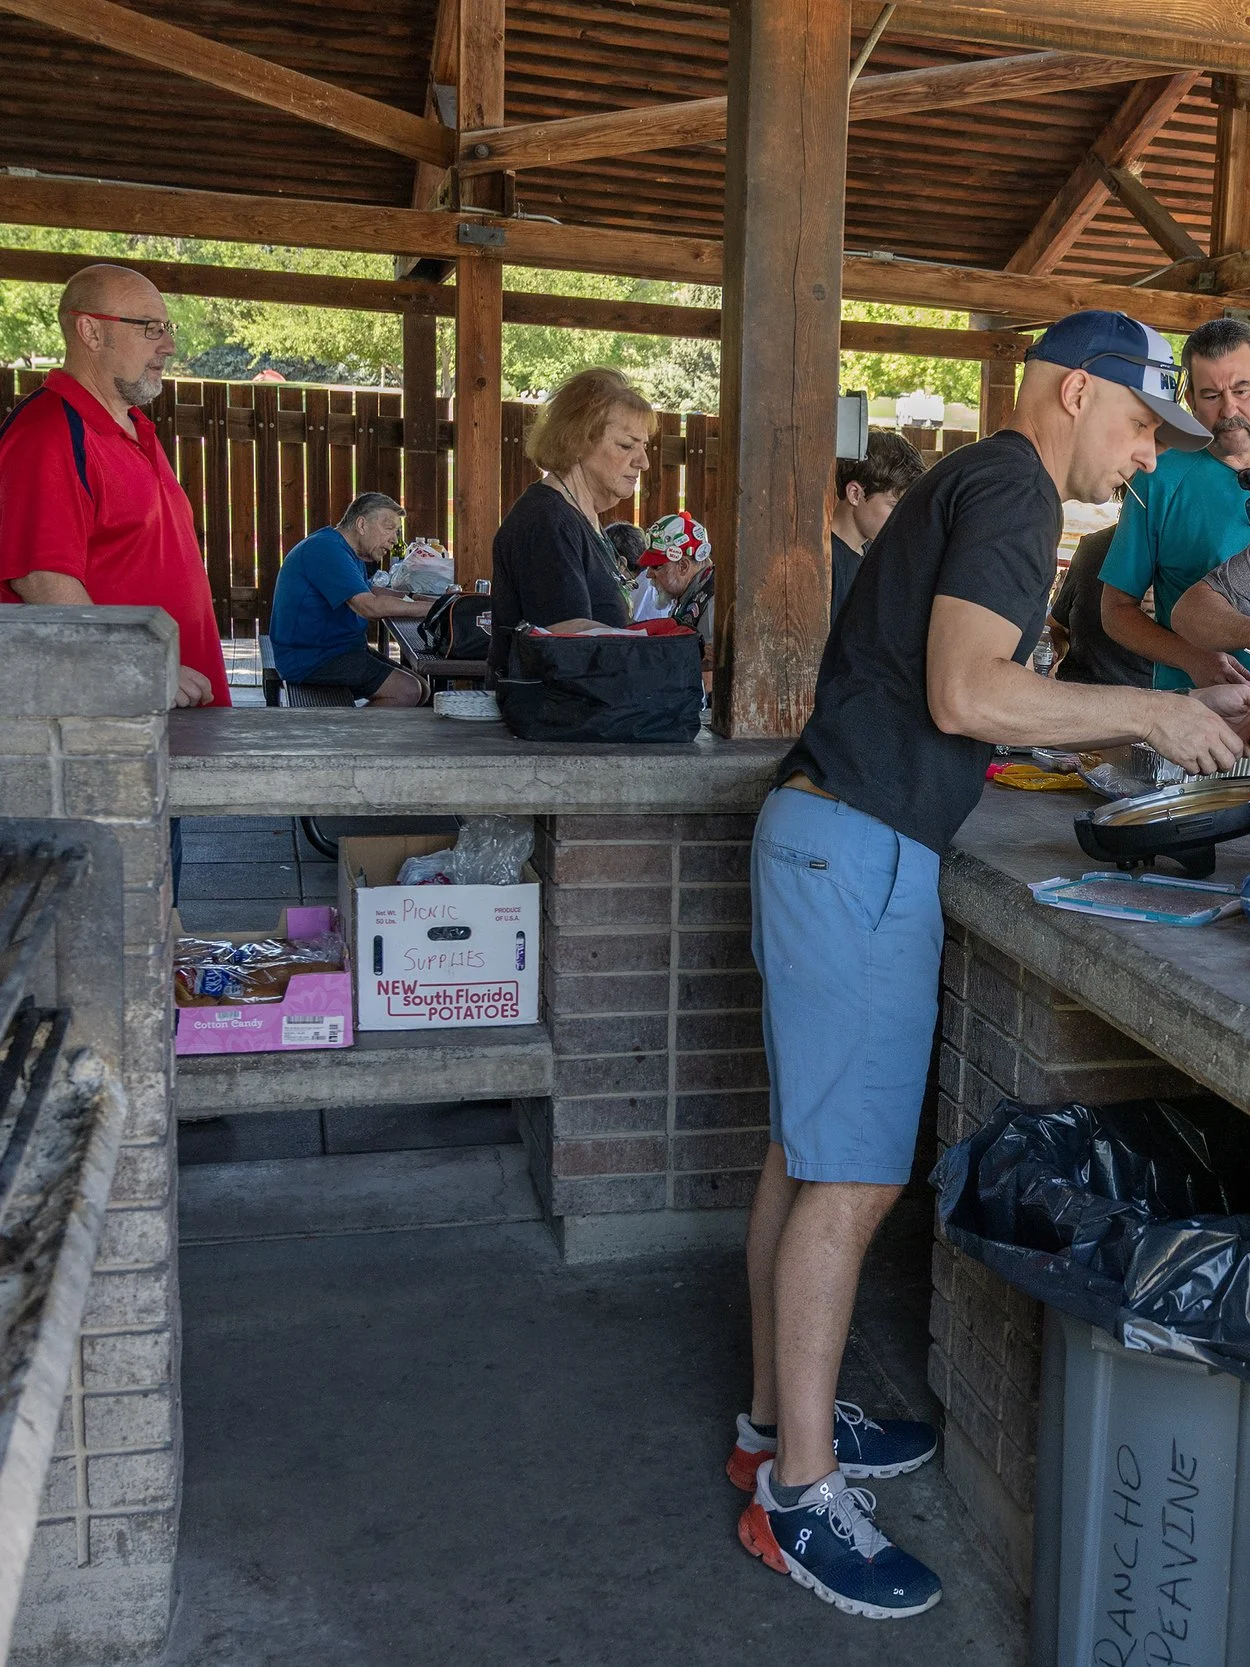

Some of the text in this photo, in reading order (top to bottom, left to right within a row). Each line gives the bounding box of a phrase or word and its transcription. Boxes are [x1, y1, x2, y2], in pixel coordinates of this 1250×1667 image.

[402, 898, 459, 921] PICNIC
[403, 947, 486, 971] SUPPLIES
[377, 980, 418, 996] NEW
[403, 986, 514, 1006] south Florida
[428, 1003, 519, 1021] POTATOES
[193, 1018, 264, 1029] Cotton Candy
[1093, 1444, 1144, 1667] RANCHO
[1143, 1437, 1200, 1667] PEAVINE
